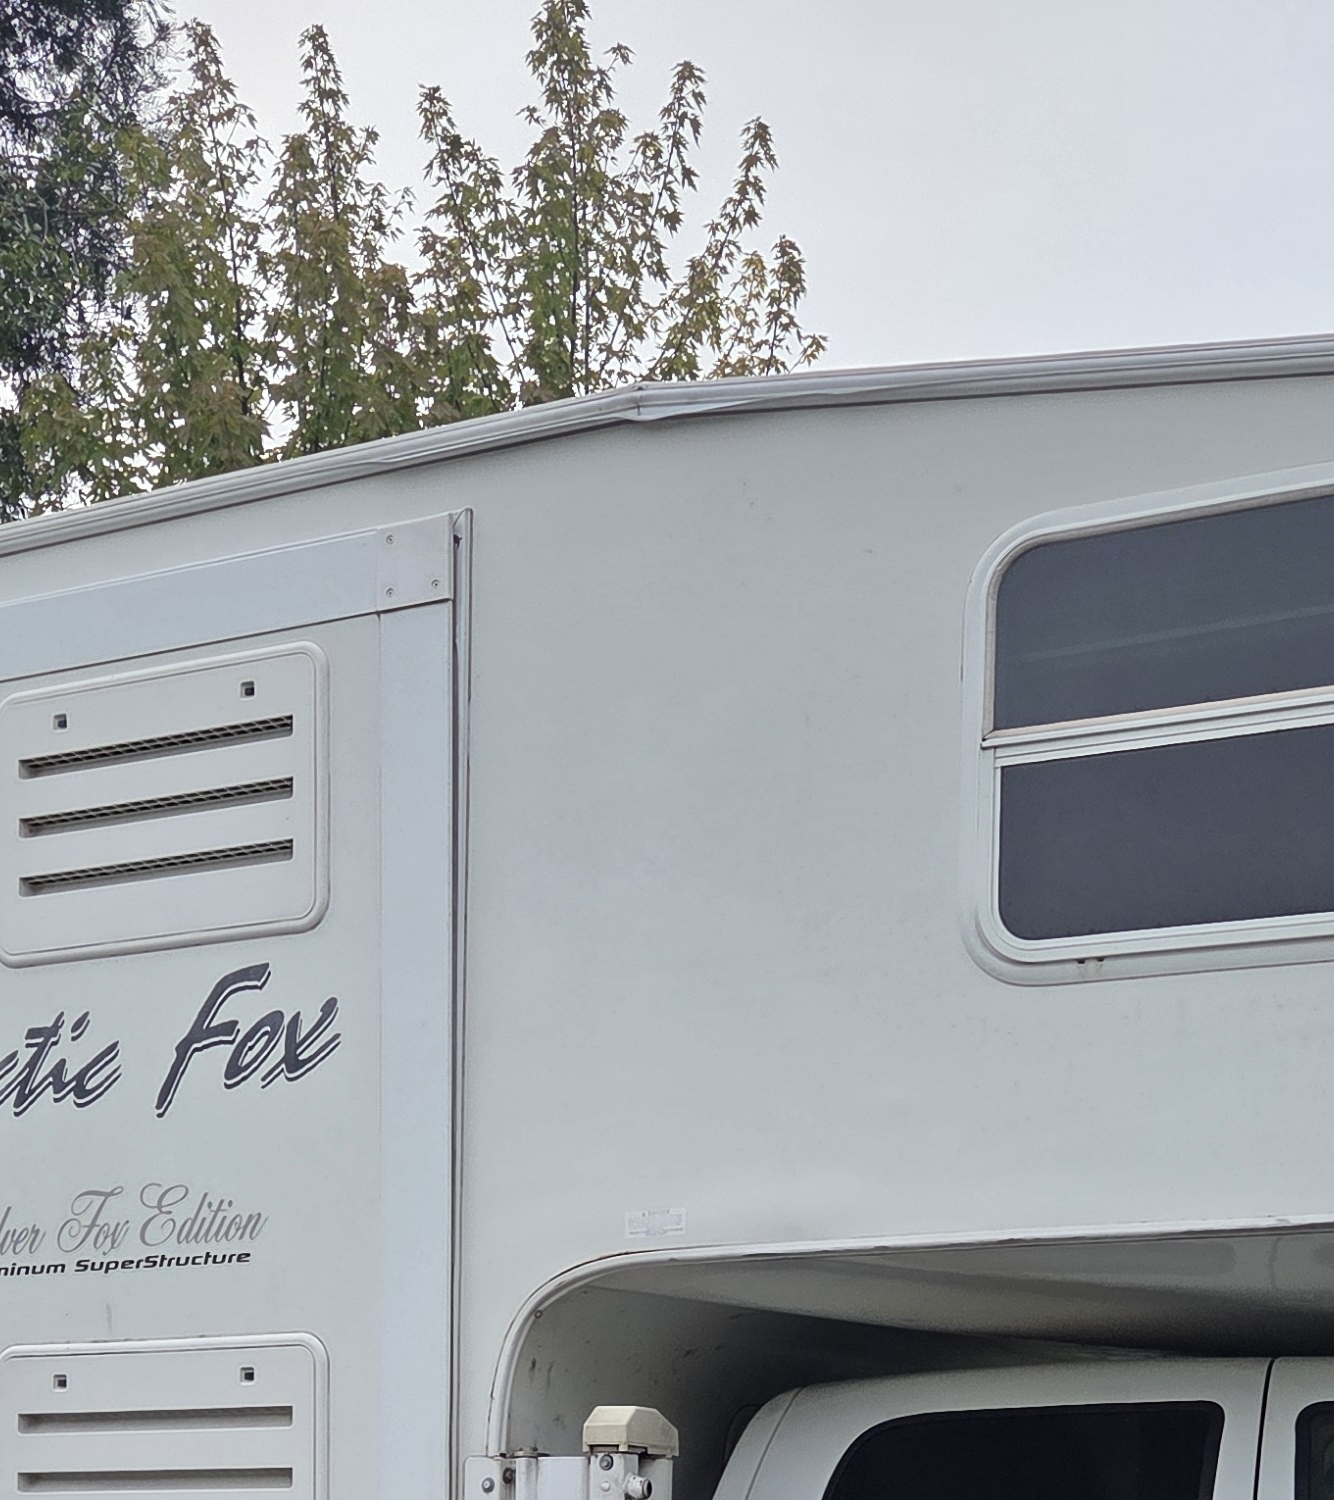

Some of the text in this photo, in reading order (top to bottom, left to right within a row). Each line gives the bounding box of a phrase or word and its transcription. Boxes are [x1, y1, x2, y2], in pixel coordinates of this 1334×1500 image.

[155, 962, 341, 1118] Fox
[57, 1186, 130, 1255] Fox
[139, 1183, 269, 1247] Edition
[74, 1251, 252, 1274] SuperStructure
